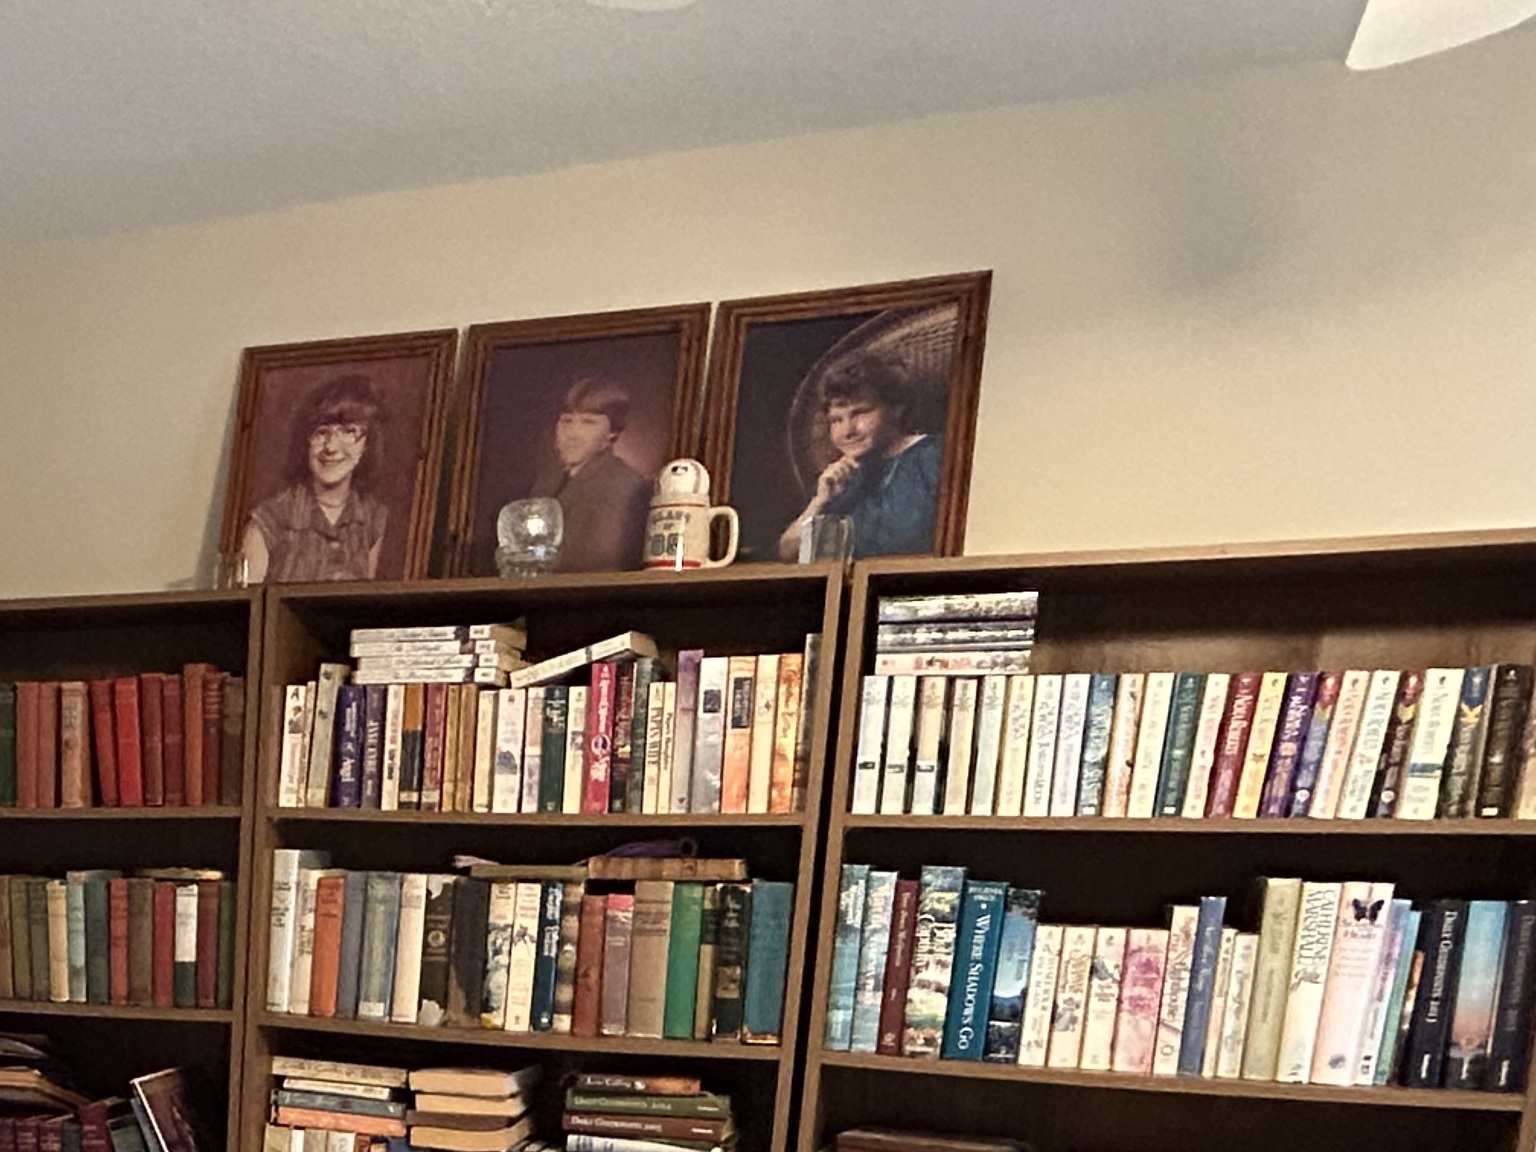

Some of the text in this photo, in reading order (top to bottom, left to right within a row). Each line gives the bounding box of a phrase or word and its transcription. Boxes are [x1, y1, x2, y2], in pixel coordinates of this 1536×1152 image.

[1232, 694, 1253, 718] NORA
[972, 915, 991, 960] WHERE
[962, 963, 982, 1024] SHADOWS
